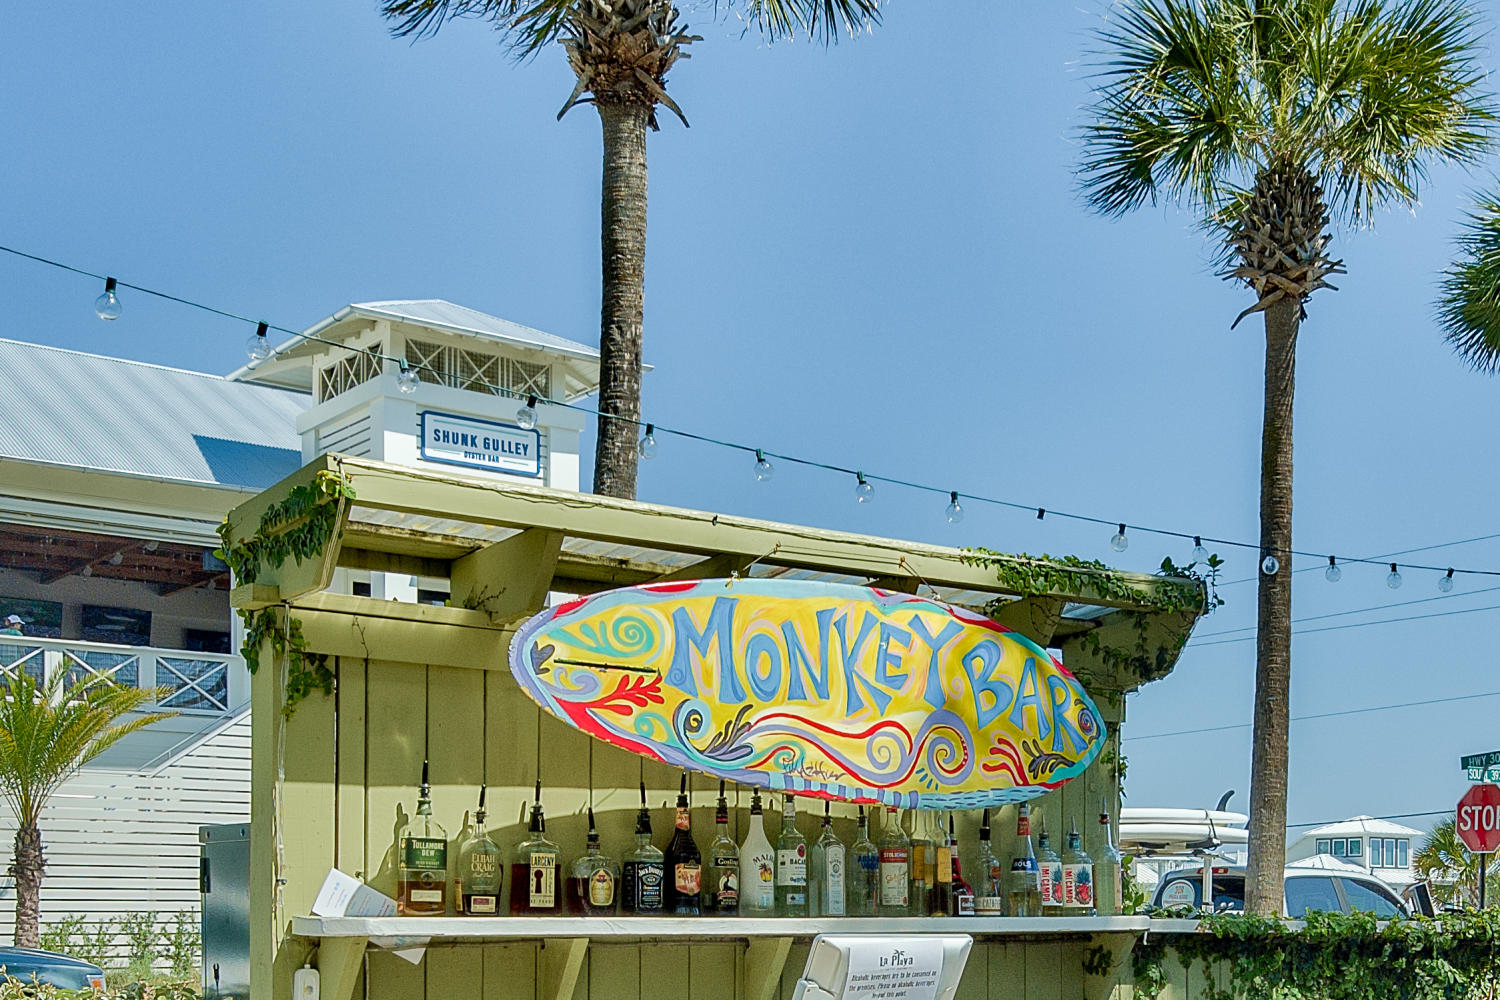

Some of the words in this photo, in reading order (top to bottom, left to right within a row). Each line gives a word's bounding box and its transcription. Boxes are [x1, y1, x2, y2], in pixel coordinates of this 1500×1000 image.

[434, 428, 478, 448] SHUNK
[483, 437, 529, 456] GULLEY
[464, 450, 486, 461] OYSTER
[488, 454, 500, 463] BAR
[664, 596, 964, 716] MONKEY
[962, 640, 1088, 755] BAR
[1469, 755, 1486, 766] HWY
[1490, 753, 1500, 764] 30
[412, 840, 444, 850] TULLAMORE
[471, 853, 495, 863] ELIJAH
[471, 862, 495, 872] CRAIG
[880, 956, 888, 967] La
[891, 953, 914, 967] Playa
